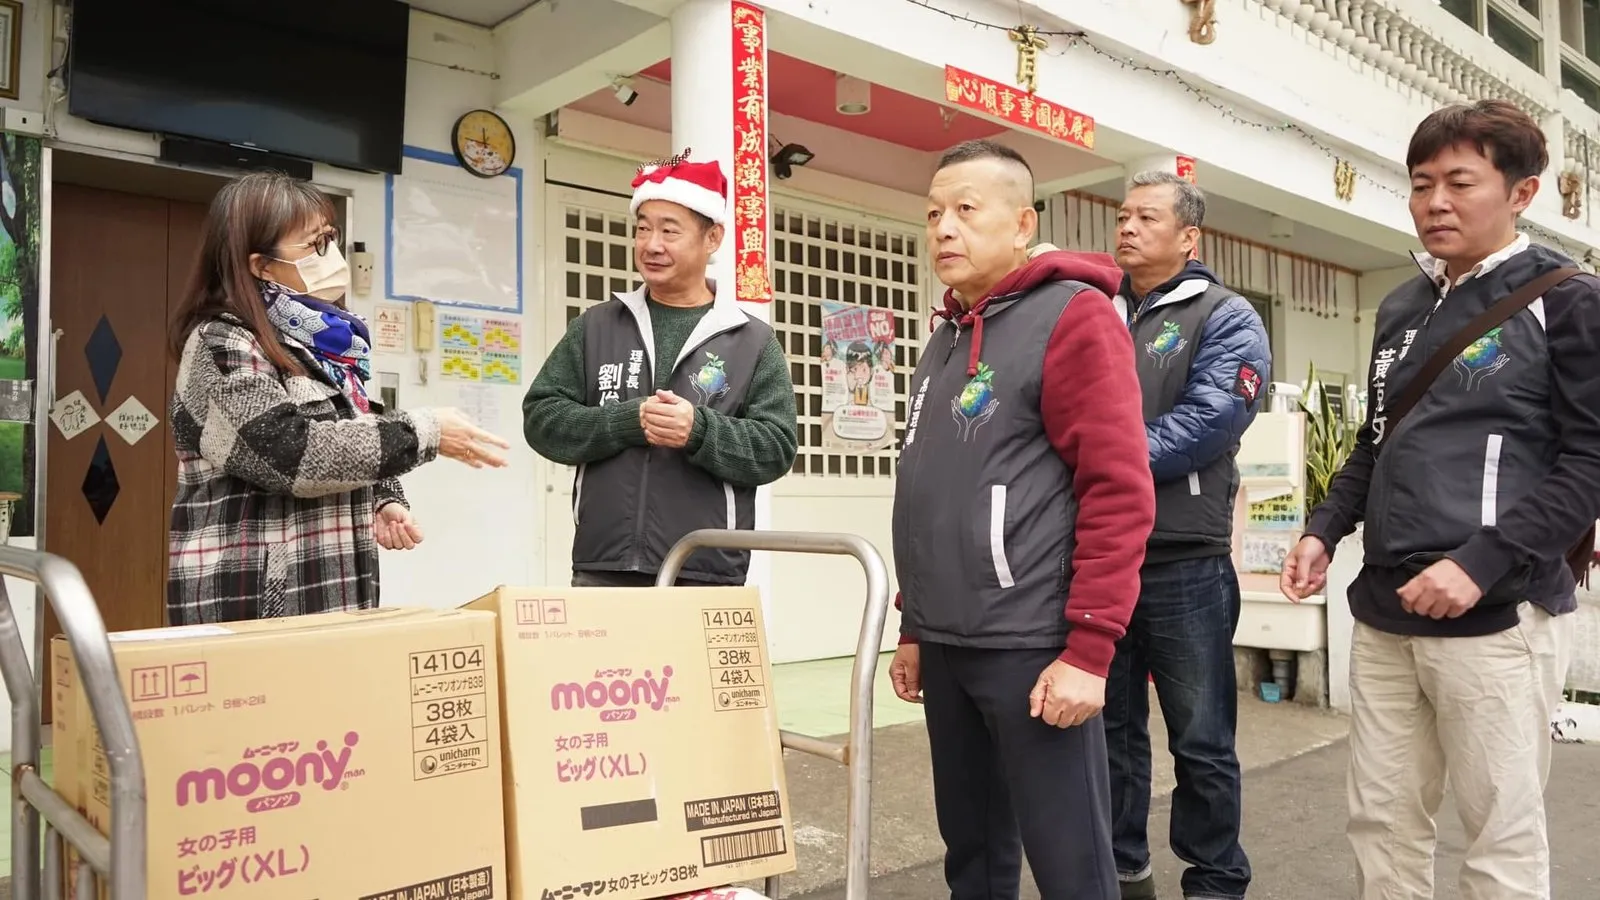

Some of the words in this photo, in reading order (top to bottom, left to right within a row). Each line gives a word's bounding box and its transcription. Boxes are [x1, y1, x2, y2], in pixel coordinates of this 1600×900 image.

[626, 350, 644, 390] 理事長
[704, 611, 754, 626] 14104
[412, 649, 482, 674] 14104
[718, 649, 752, 665] 38枚
[595, 668, 632, 679] ムーニーマン
[720, 669, 755, 685] 4袋入
[413, 675, 483, 696] ムーニーマンオンナB38
[551, 665, 673, 711] moony
[665, 695, 680, 703] man
[731, 688, 761, 699] unicharm
[426, 698, 472, 721] 38枚
[606, 710, 631, 720] パンツ
[425, 723, 475, 745] 4袋入
[555, 732, 609, 752] 女の子用
[242, 741, 300, 759] ムーニーマン
[439, 746, 480, 761] unicharm
[176, 731, 359, 806] moony
[344, 768, 366, 779] man
[256, 794, 293, 809] パンツ
[686, 802, 711, 819] MADE
[711, 801, 720, 815] IN
[721, 798, 746, 814] JAPAN
[702, 812, 750, 826] (Manufactured
[751, 810, 758, 819] in
[759, 807, 780, 818] Japan)
[176, 825, 256, 858] 女の子用
[410, 881, 445, 900] JAPAN
